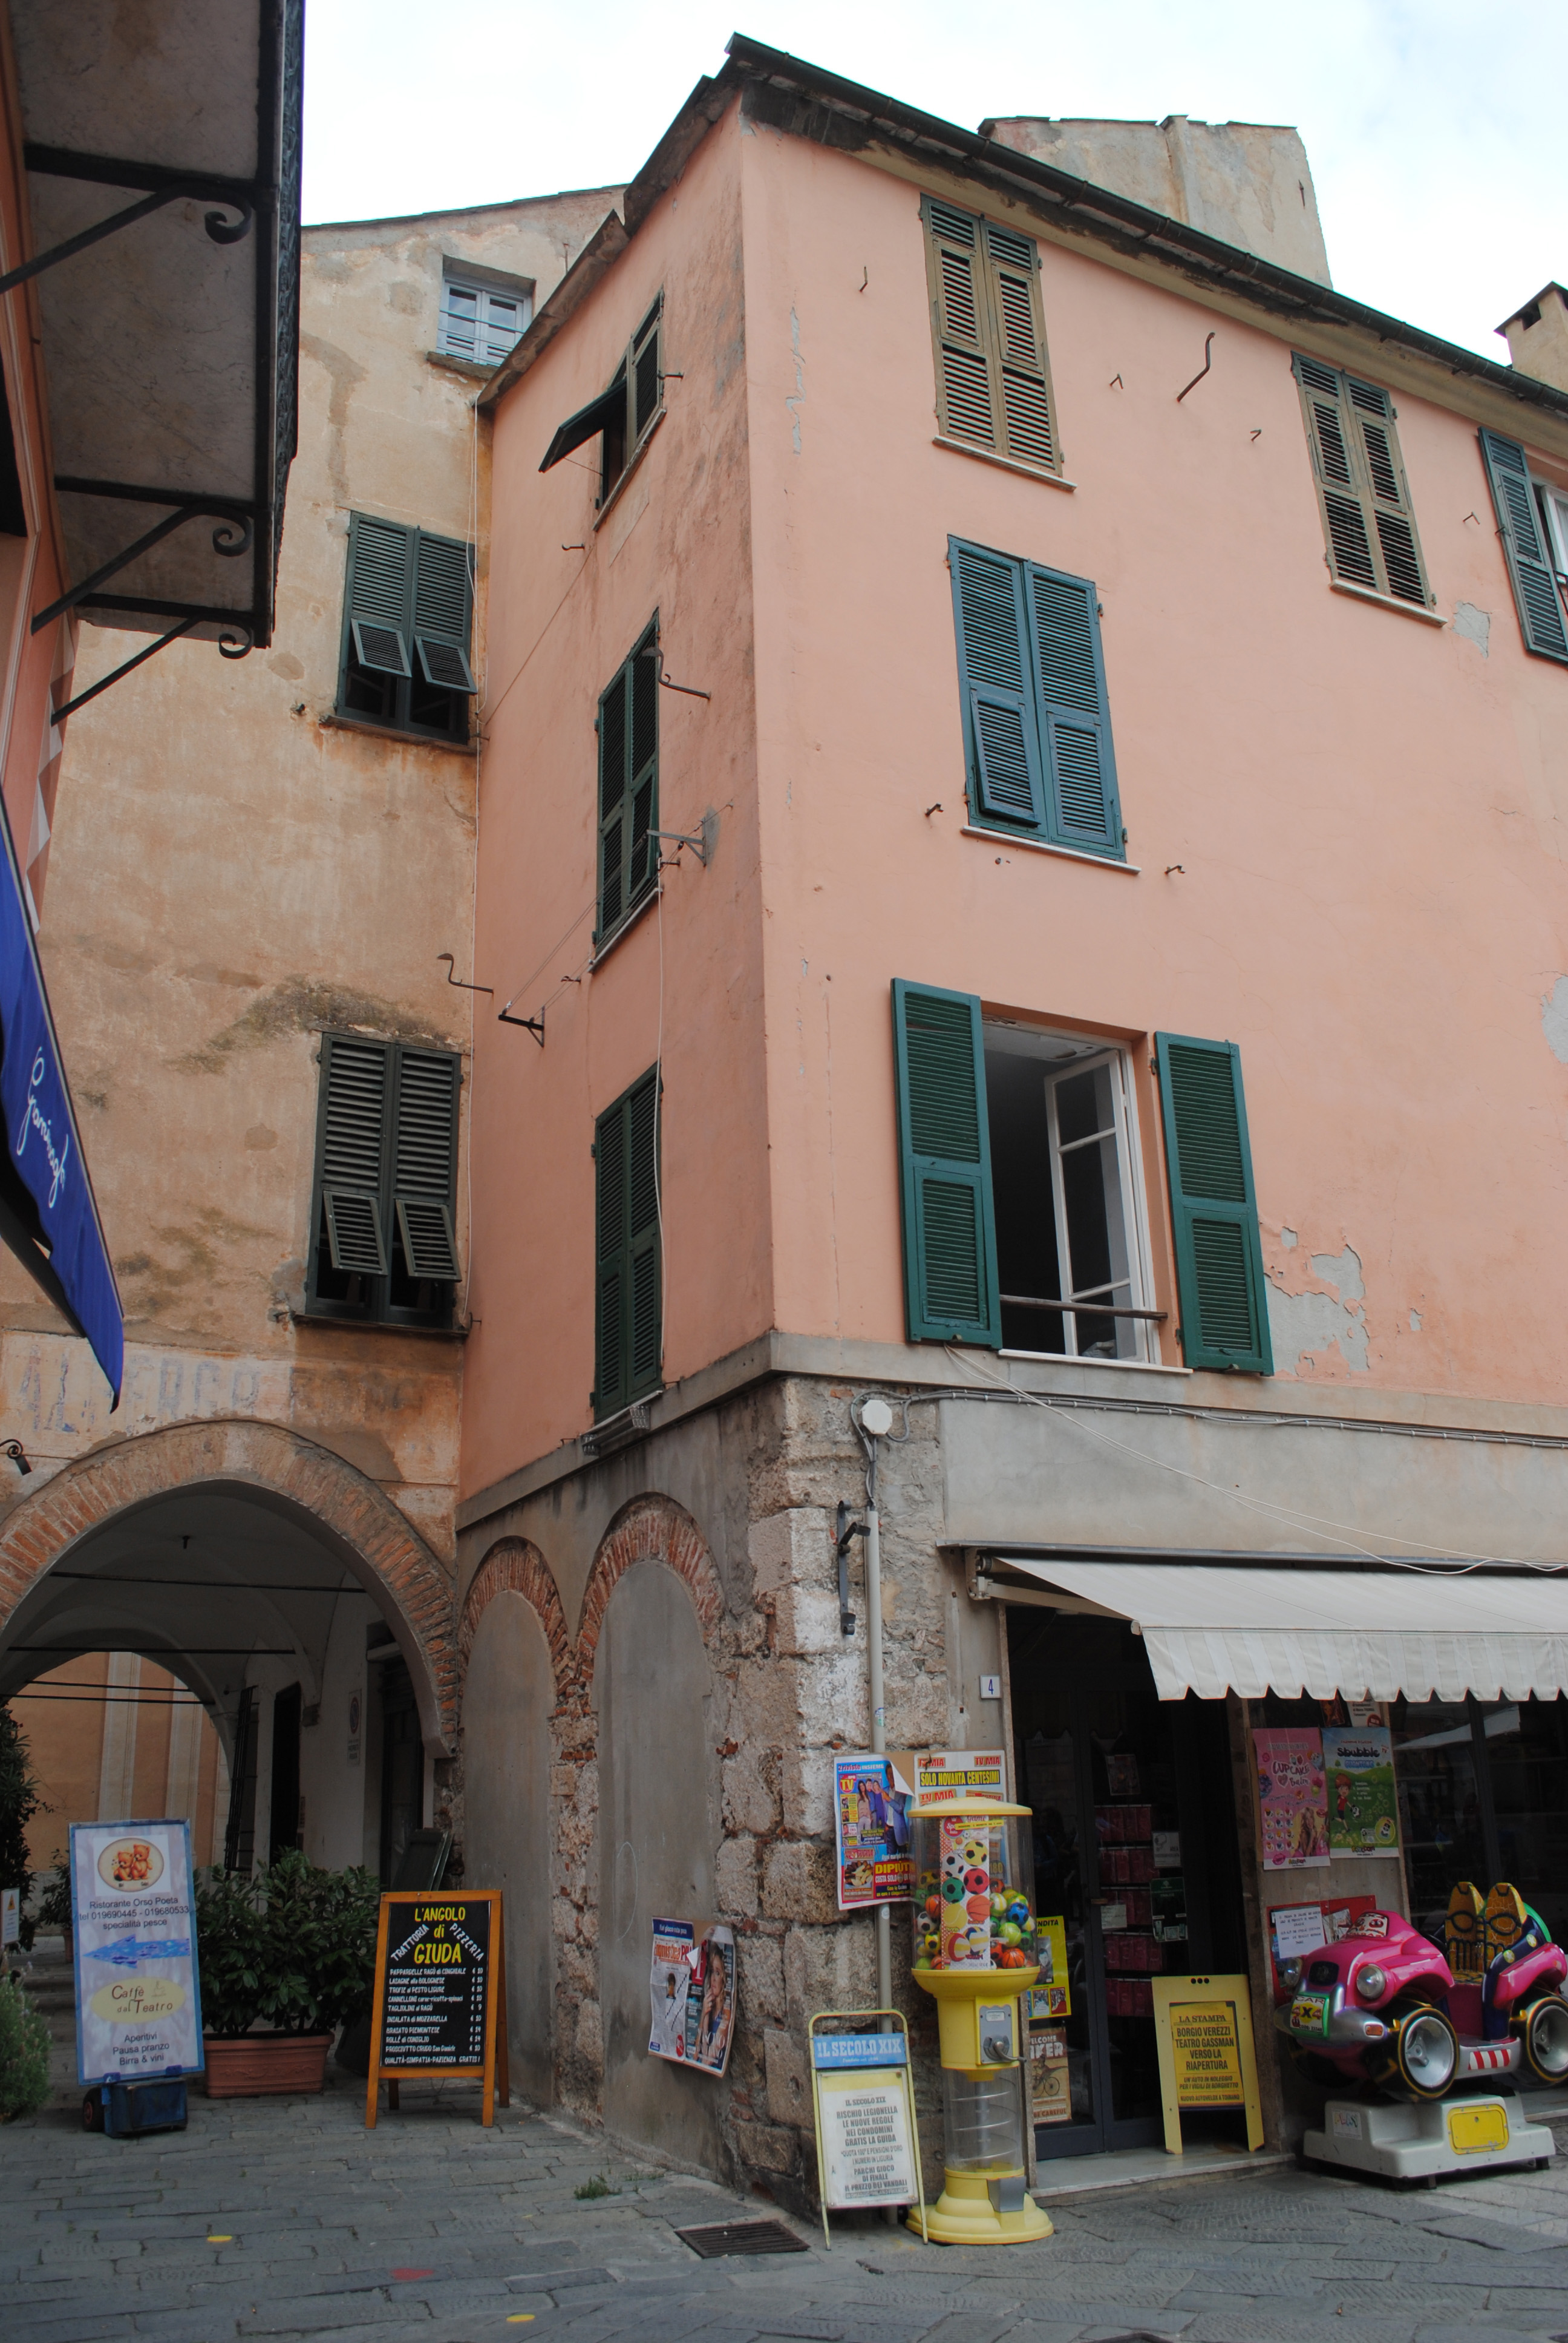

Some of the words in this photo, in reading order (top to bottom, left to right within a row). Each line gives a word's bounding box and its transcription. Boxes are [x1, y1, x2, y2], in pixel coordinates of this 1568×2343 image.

[988, 1679, 994, 1694] 4
[975, 1757, 985, 1766] TV
[985, 1756, 1000, 1765] MIA
[1272, 1761, 1310, 1775] CUPCAKE
[921, 1773, 936, 1786] SOLO
[938, 1772, 966, 1785] NOVANTA
[967, 1771, 999, 1784] CENTESIMI
[840, 1779, 854, 1791] TV
[920, 1793, 932, 1802] TV
[934, 1790, 954, 1801] MIA
[90, 1899, 131, 1909] Ristorante
[91, 1909, 137, 1919] 019690445
[145, 1906, 189, 1916] 019680533
[414, 1907, 466, 1922] L'ANGOLO
[103, 1919, 141, 1930] specialità
[143, 1919, 168, 1928] pesce
[434, 1924, 445, 1938] di
[390, 1924, 430, 1961] TRATTORIA
[449, 1922, 484, 1961] PIZZERIA
[414, 1943, 462, 1964] GIUDA
[117, 1999, 131, 2013] dal
[132, 1999, 173, 2014] Teatro
[124, 2031, 157, 2043] Aperitivi
[1177, 2027, 1202, 2037] BORGIO
[1203, 2026, 1230, 2036] VEREZZI
[113, 2045, 139, 2055] Pausa
[142, 2042, 170, 2053] pranzo
[817, 2042, 830, 2057] IL
[832, 2040, 877, 2056] SECOLO
[879, 2038, 901, 2054] XIX
[1175, 2038, 1200, 2048] TEATRO
[1201, 2037, 1234, 2047] GASSMAN
[1030, 2042, 1063, 2059] IKER
[1190, 2049, 1212, 2059] VERSO
[1213, 2049, 1222, 2059] LA
[119, 2056, 139, 2065] Birra
[150, 2053, 164, 2062] vini
[1186, 2060, 1228, 2069] RIAPERTURA
[837, 2109, 862, 2119] RISCHIO
[863, 2106, 898, 2117] LEGIONELLA
[1042, 2108, 1067, 2117] CAREFUL
[851, 2117, 870, 2126] NUOVE
[872, 2115, 894, 2124] REGOLE
[846, 2128, 856, 2137] NEI
[858, 2125, 893, 2135] CONDOMINI
[845, 2137, 867, 2146] GRATIS
[877, 2134, 897, 2143] GUIDA
[854, 2166, 875, 2175] PARCHI
[877, 2164, 895, 2173] GIOCO
[870, 2173, 888, 2181] FINALE
[852, 2183, 872, 2191] PREZZO
[883, 2179, 907, 2188] VANDALI
